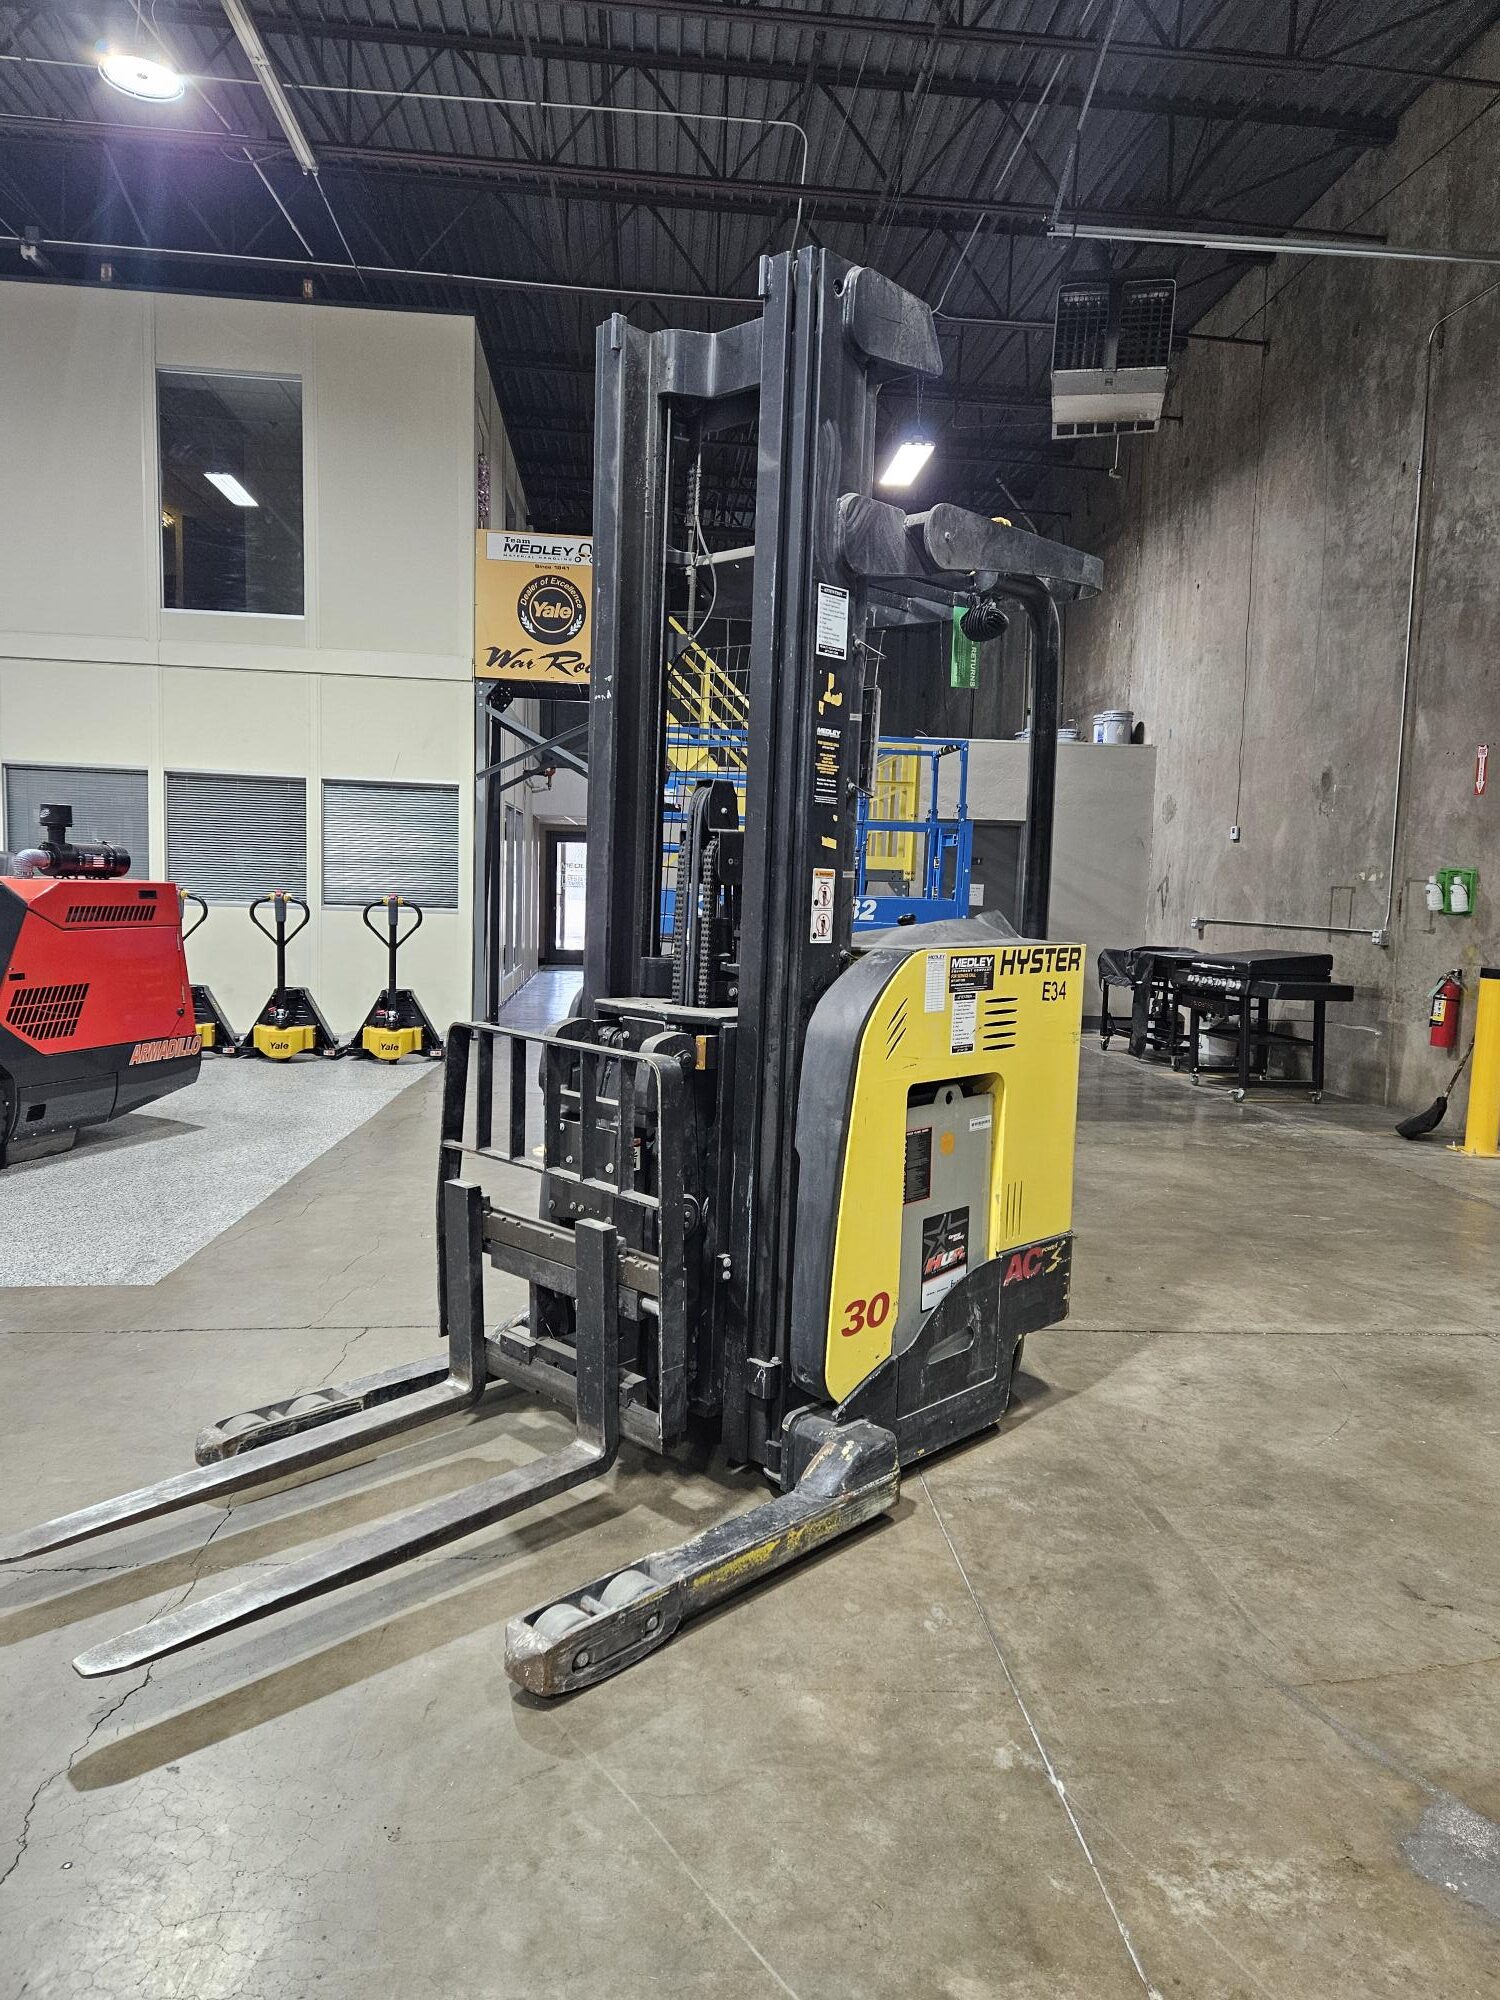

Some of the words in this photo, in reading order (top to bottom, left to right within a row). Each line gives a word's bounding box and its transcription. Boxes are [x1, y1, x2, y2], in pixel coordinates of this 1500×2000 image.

[503, 543, 575, 556] MEDLEY
[504, 536, 531, 545] Team
[520, 582, 538, 606] Dealer
[540, 577, 549, 586] of
[550, 577, 583, 609] Excellence
[533, 600, 572, 619] Yale
[482, 646, 537, 670] War
[816, 727, 842, 736] MEDLEY
[952, 956, 994, 968] MEDLEY
[999, 947, 1082, 975] HYSTER
[1042, 980, 1067, 1001] E34
[128, 1034, 202, 1066] ARMADILLO
[270, 1041, 290, 1050] Yale
[380, 1042, 400, 1051] Yale
[1003, 1246, 1043, 1287] AC
[840, 1291, 891, 1338] 30
